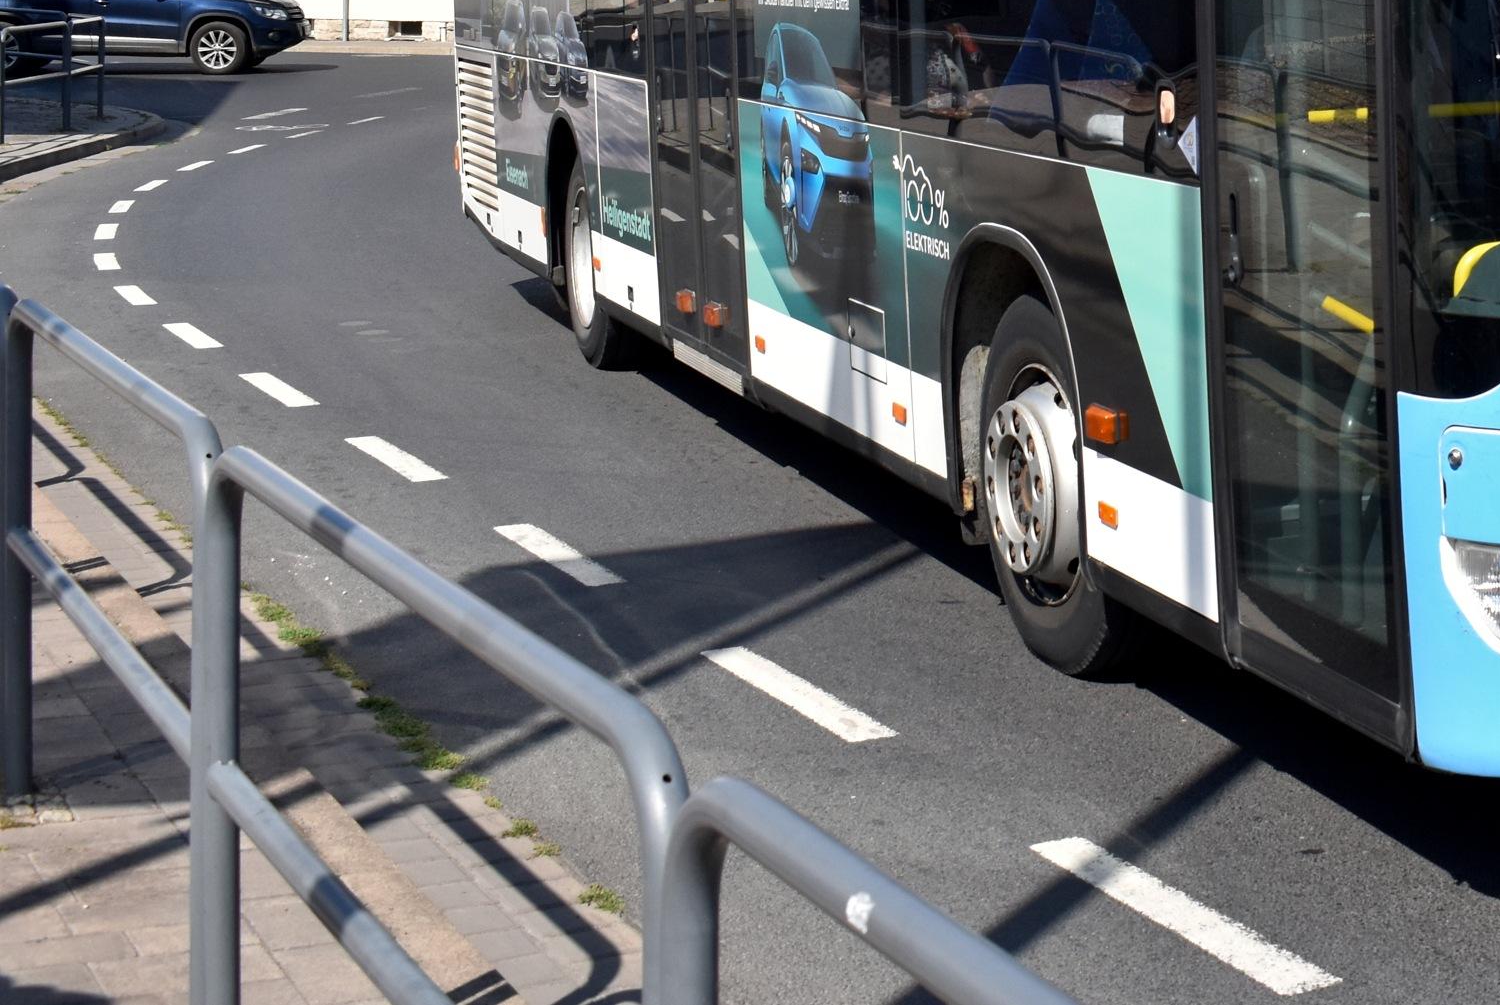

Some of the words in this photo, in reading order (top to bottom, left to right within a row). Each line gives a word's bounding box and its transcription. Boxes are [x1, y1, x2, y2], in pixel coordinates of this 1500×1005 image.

[505, 157, 529, 190] Eisenach
[602, 195, 651, 242] Heiligenstadt
[905, 230, 950, 261] ELEKTRISCH
